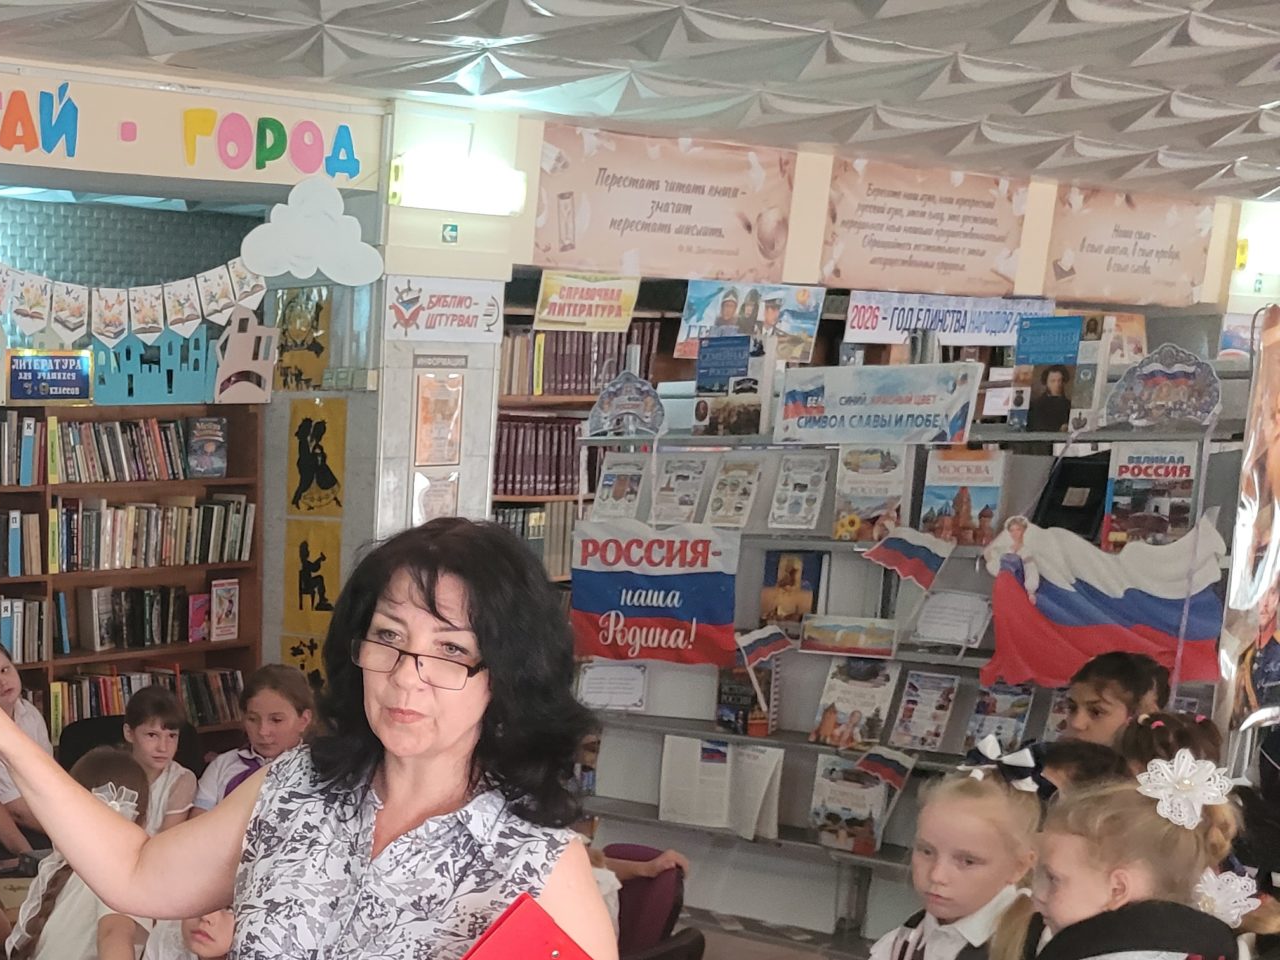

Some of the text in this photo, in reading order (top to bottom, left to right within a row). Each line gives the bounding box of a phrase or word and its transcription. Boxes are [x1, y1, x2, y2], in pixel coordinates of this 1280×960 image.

[181, 107, 361, 179] ГОРОД
[595, 167, 661, 193] Перестать
[647, 200, 693, 219] значит
[608, 217, 672, 238] перестать
[427, 294, 479, 310] БИБЛИО-
[547, 300, 624, 318] ЛИТЕРАТУРА
[425, 314, 478, 330] ШТУРВАЛ
[850, 304, 880, 331] 2026
[888, 306, 913, 331] ГОД
[917, 307, 968, 334] ЕДИНСТВА
[12, 358, 82, 370] ЛИТЕРАТУРА
[796, 414, 845, 430] СИМВОЛ
[849, 414, 893, 429] СЛАВЫ
[895, 414, 904, 428] И
[1118, 465, 1191, 478] РОССИЯ
[620, 587, 684, 608] наша
[599, 609, 697, 658] Родина!
